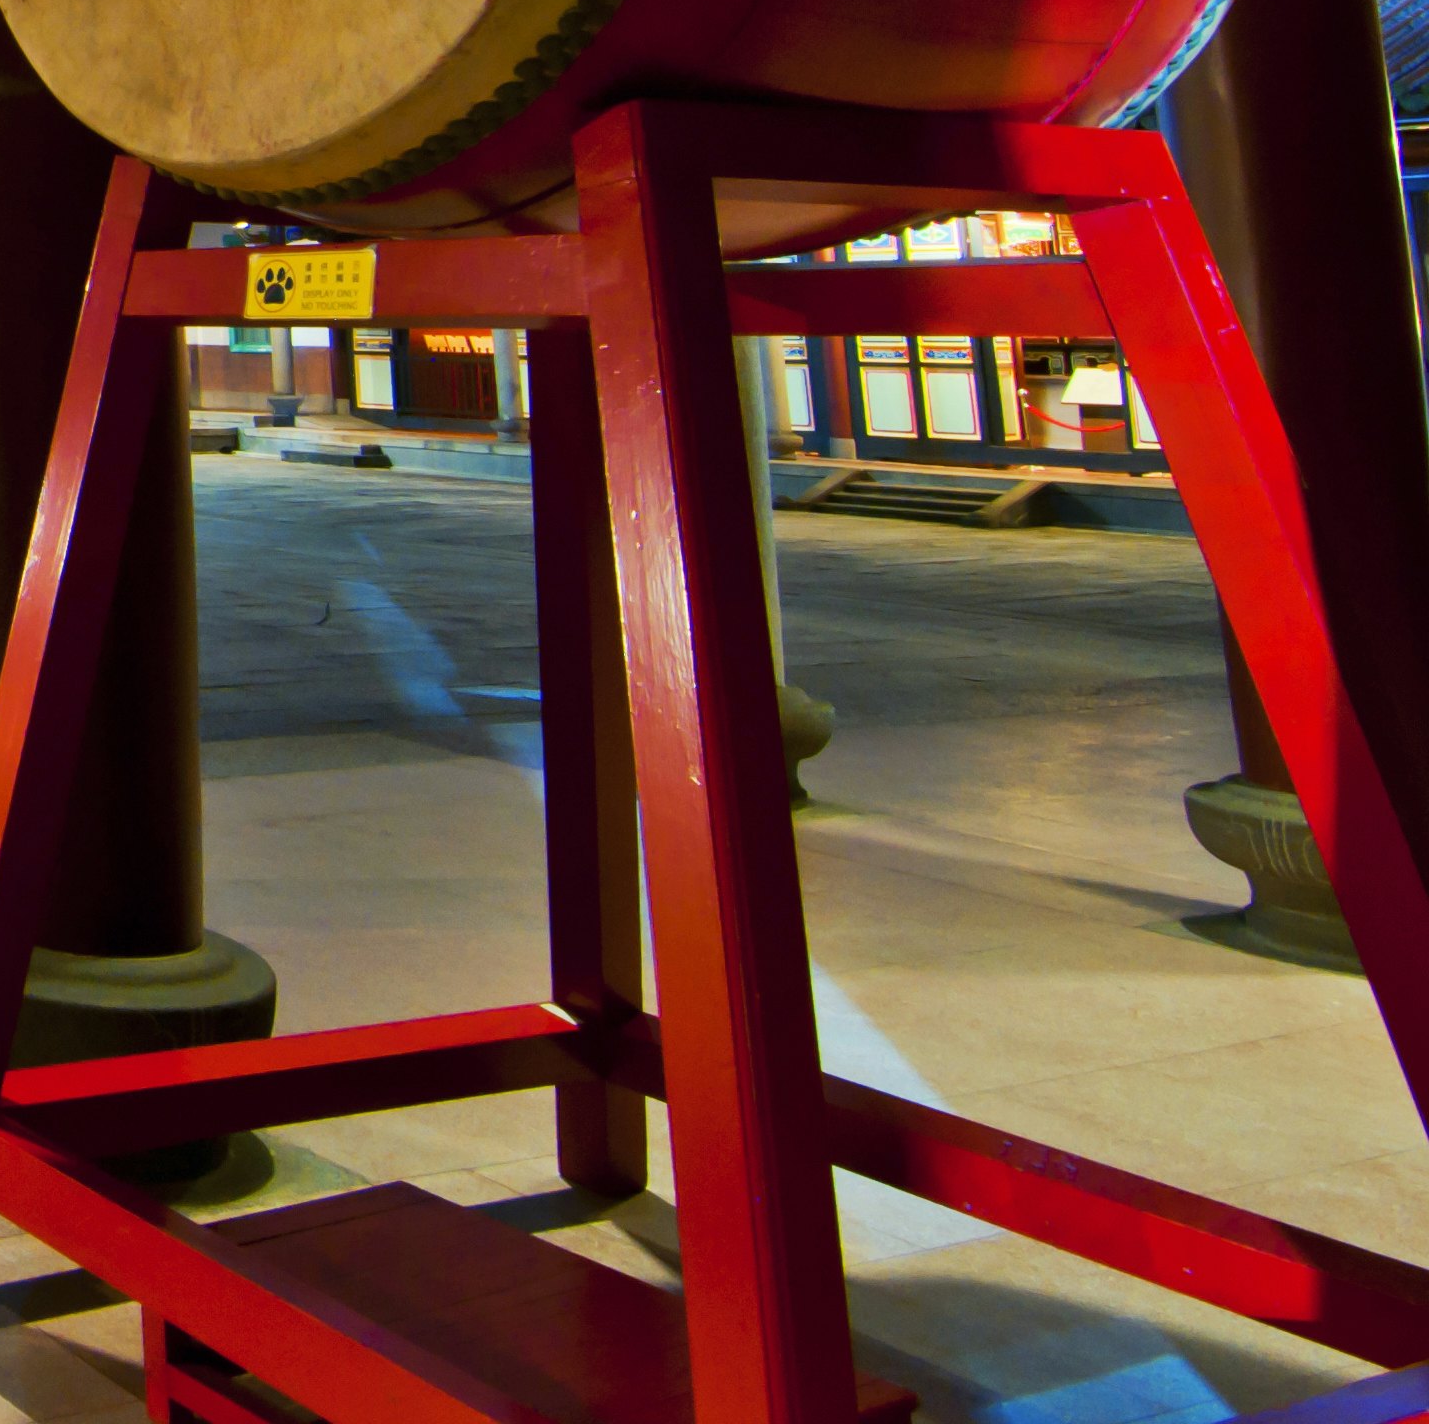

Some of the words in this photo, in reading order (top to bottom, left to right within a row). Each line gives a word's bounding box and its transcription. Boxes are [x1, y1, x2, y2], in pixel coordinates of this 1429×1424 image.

[302, 289, 334, 299] DISPLAY
[336, 289, 359, 298] ONLY
[301, 302, 314, 311] NO
[316, 301, 358, 311] TOUCHING
